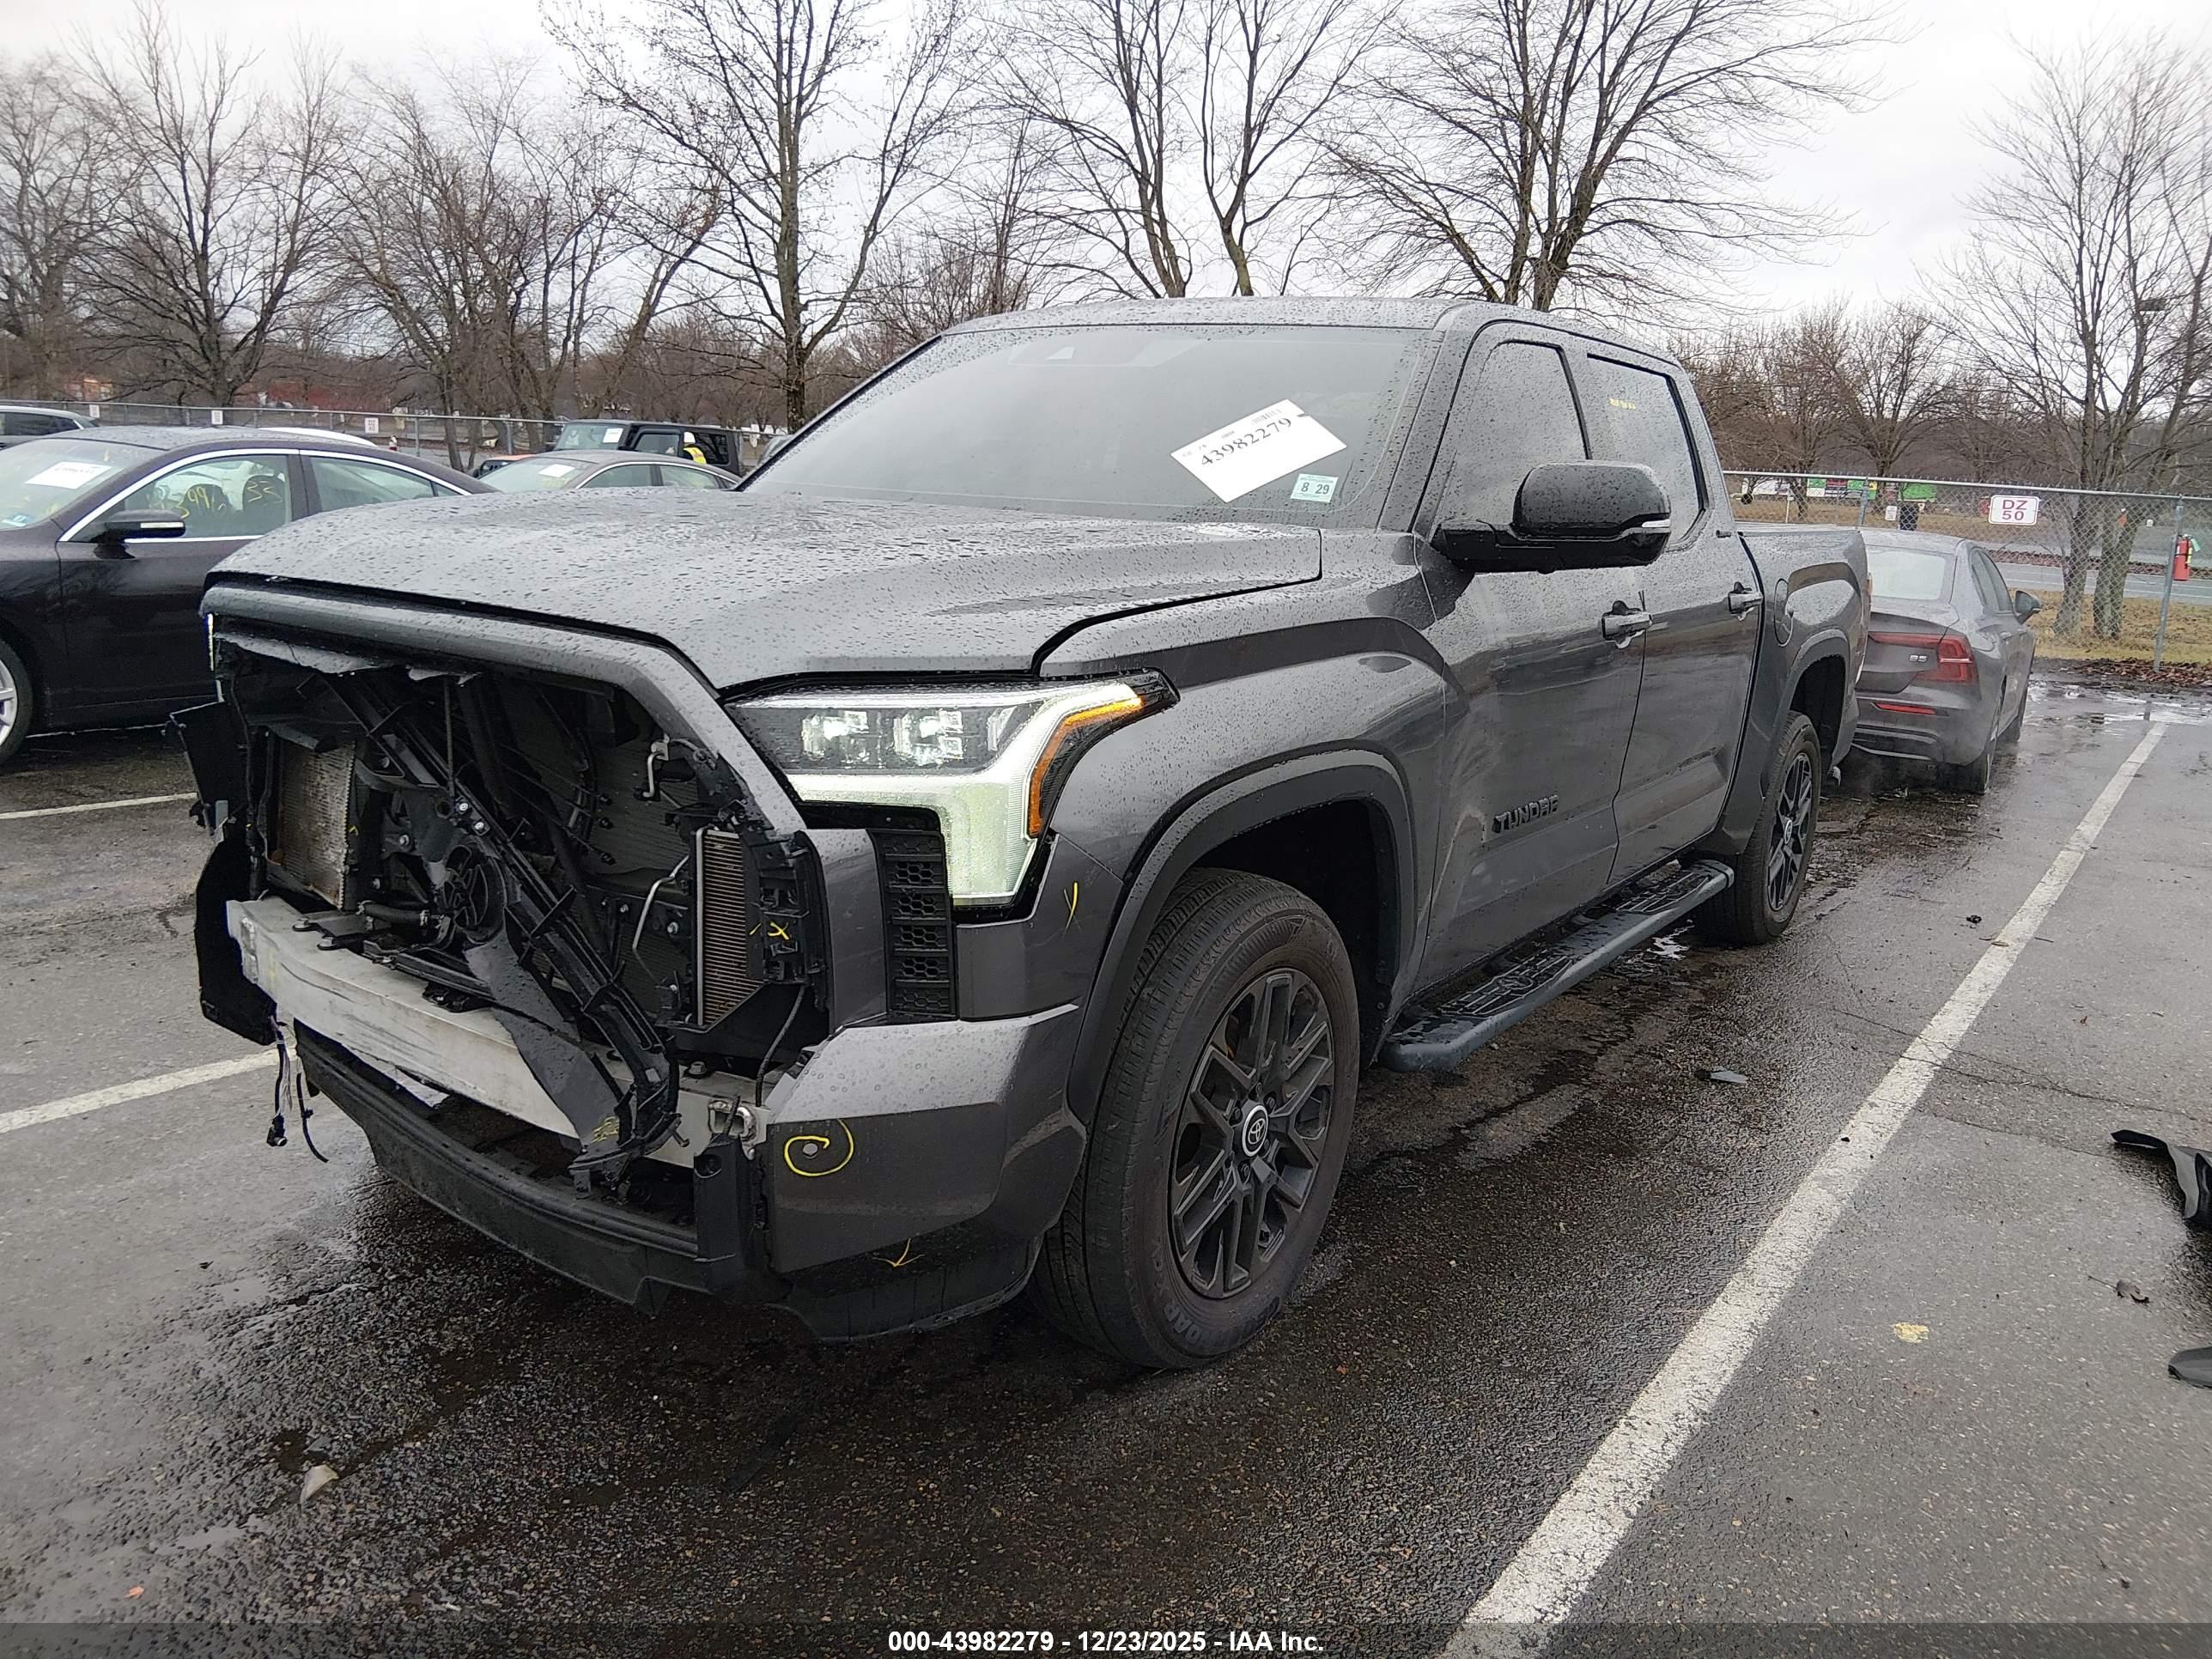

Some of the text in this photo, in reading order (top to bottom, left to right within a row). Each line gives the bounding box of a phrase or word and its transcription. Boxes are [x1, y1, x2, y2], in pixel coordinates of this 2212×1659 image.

[1201, 417, 1291, 465] 43982279
[1301, 482, 1330, 495] 8 29
[2002, 499, 2028, 511] DZ
[2002, 510, 2025, 520] 50
[1493, 794, 1559, 833] TUNDRA
